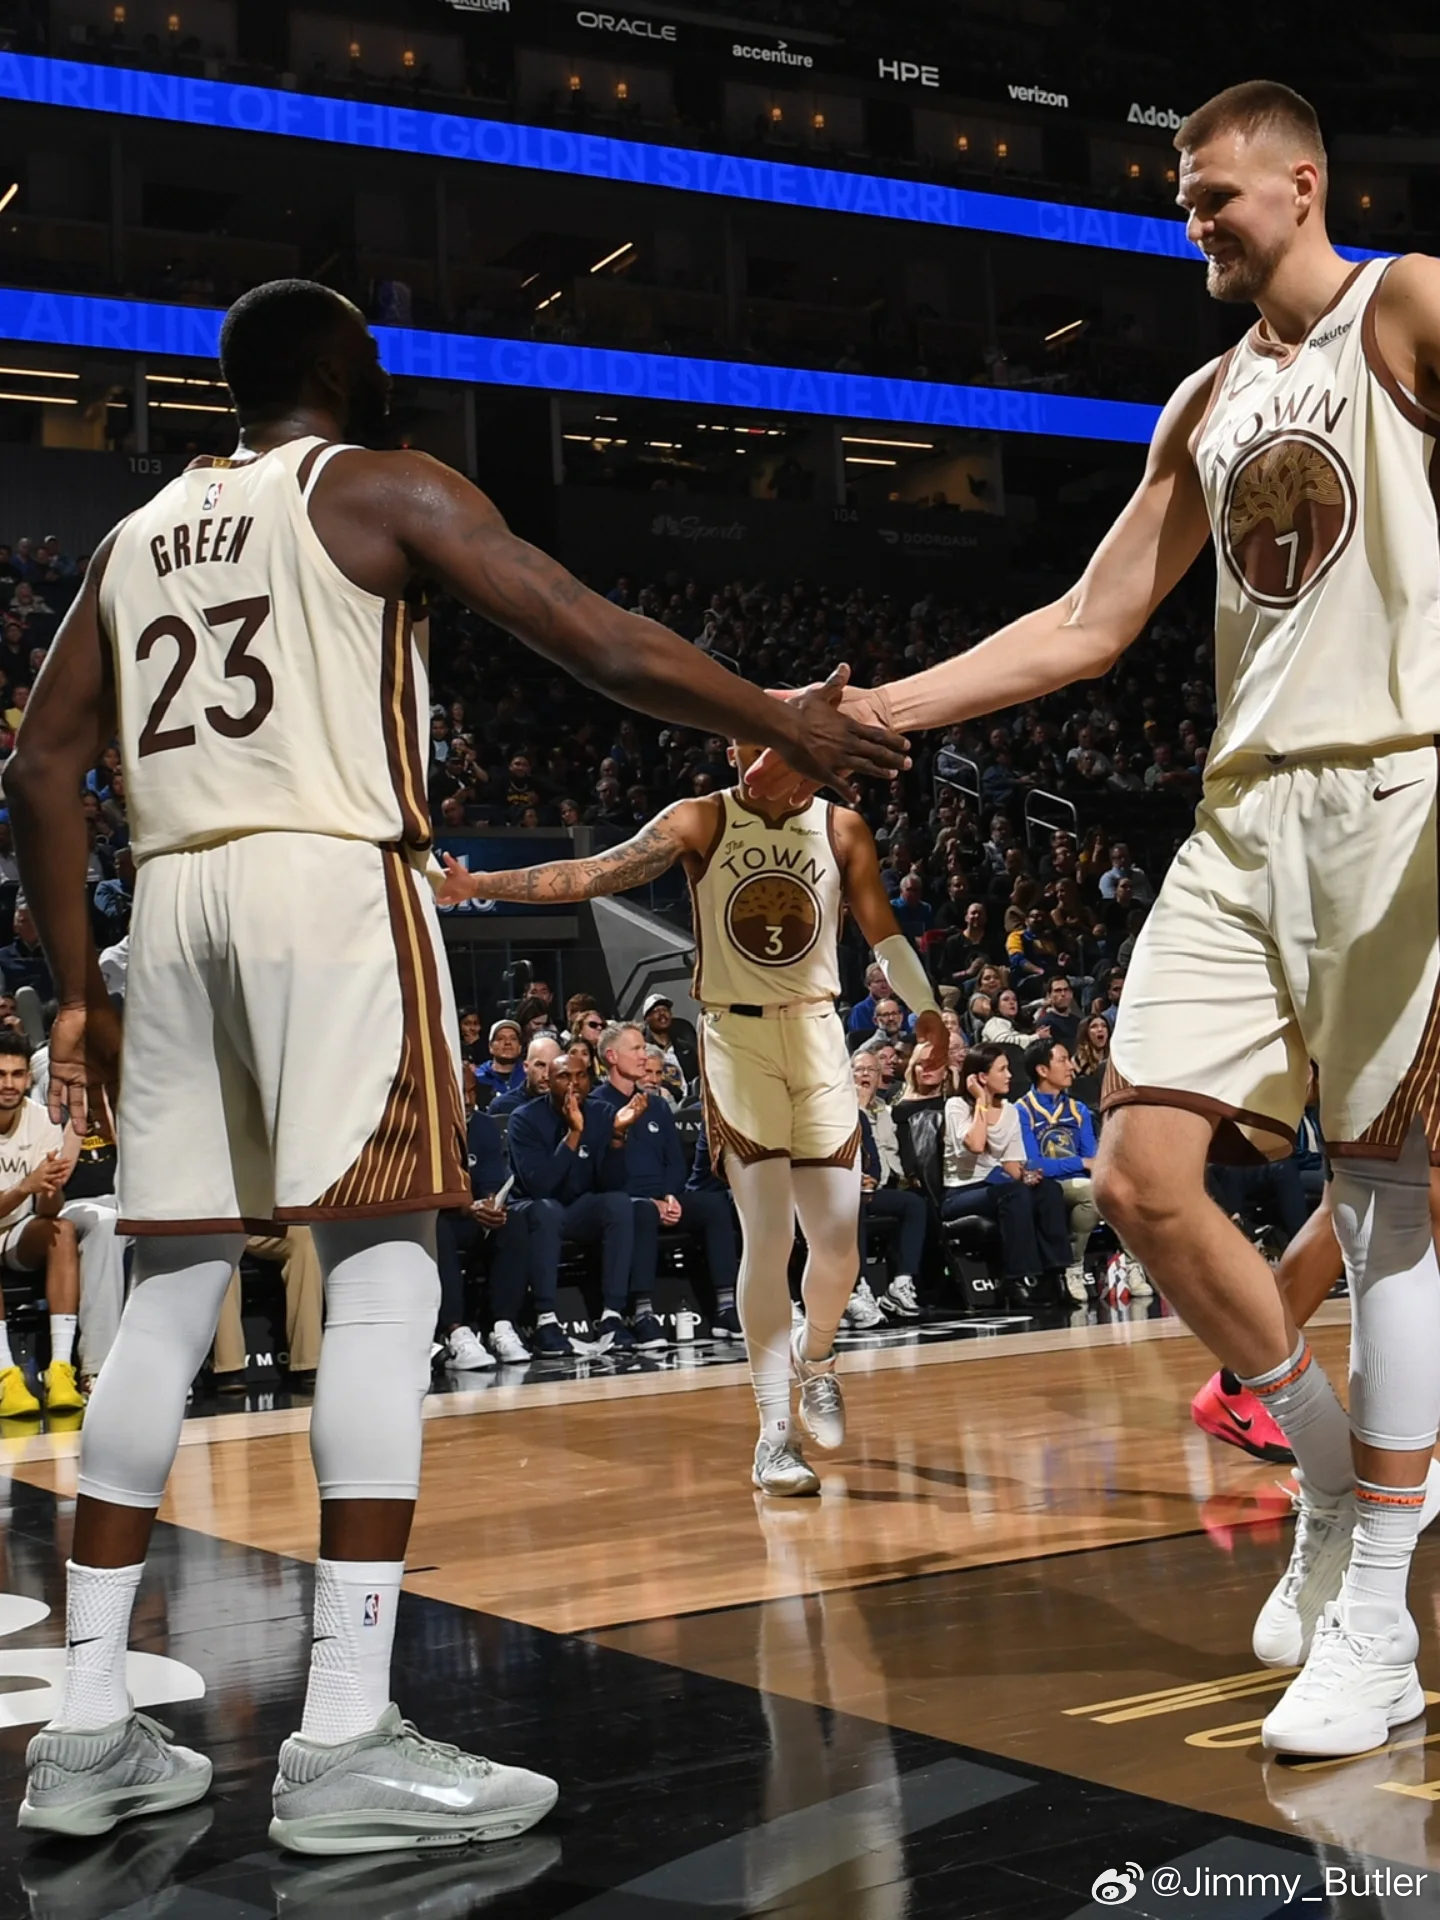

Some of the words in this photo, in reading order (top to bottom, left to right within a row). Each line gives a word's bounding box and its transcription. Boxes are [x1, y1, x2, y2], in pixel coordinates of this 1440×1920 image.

[576, 10, 678, 42] ORACLE
[732, 40, 813, 68] accenture
[878, 58, 940, 87] HPE
[1008, 84, 1069, 108] verizon
[228, 85, 303, 134] OF
[314, 97, 417, 152] THE
[430, 114, 646, 182] GOLDEN
[658, 147, 797, 203] STATE
[807, 168, 960, 226] WARRI
[1037, 203, 1128, 250] CIAL
[20, 292, 220, 358] AIRLIN
[369, 327, 476, 380] THE
[489, 339, 715, 403] GOLDEN
[728, 363, 873, 417] STATE
[883, 379, 1042, 433] WARRI
[128, 457, 162, 475] 103
[832, 508, 859, 522] 104
[150, 515, 255, 578] GREEN
[1275, 530, 1299, 589] 7
[135, 594, 274, 759] 23
[720, 845, 827, 885] TOWN
[764, 926, 784, 956] 3
